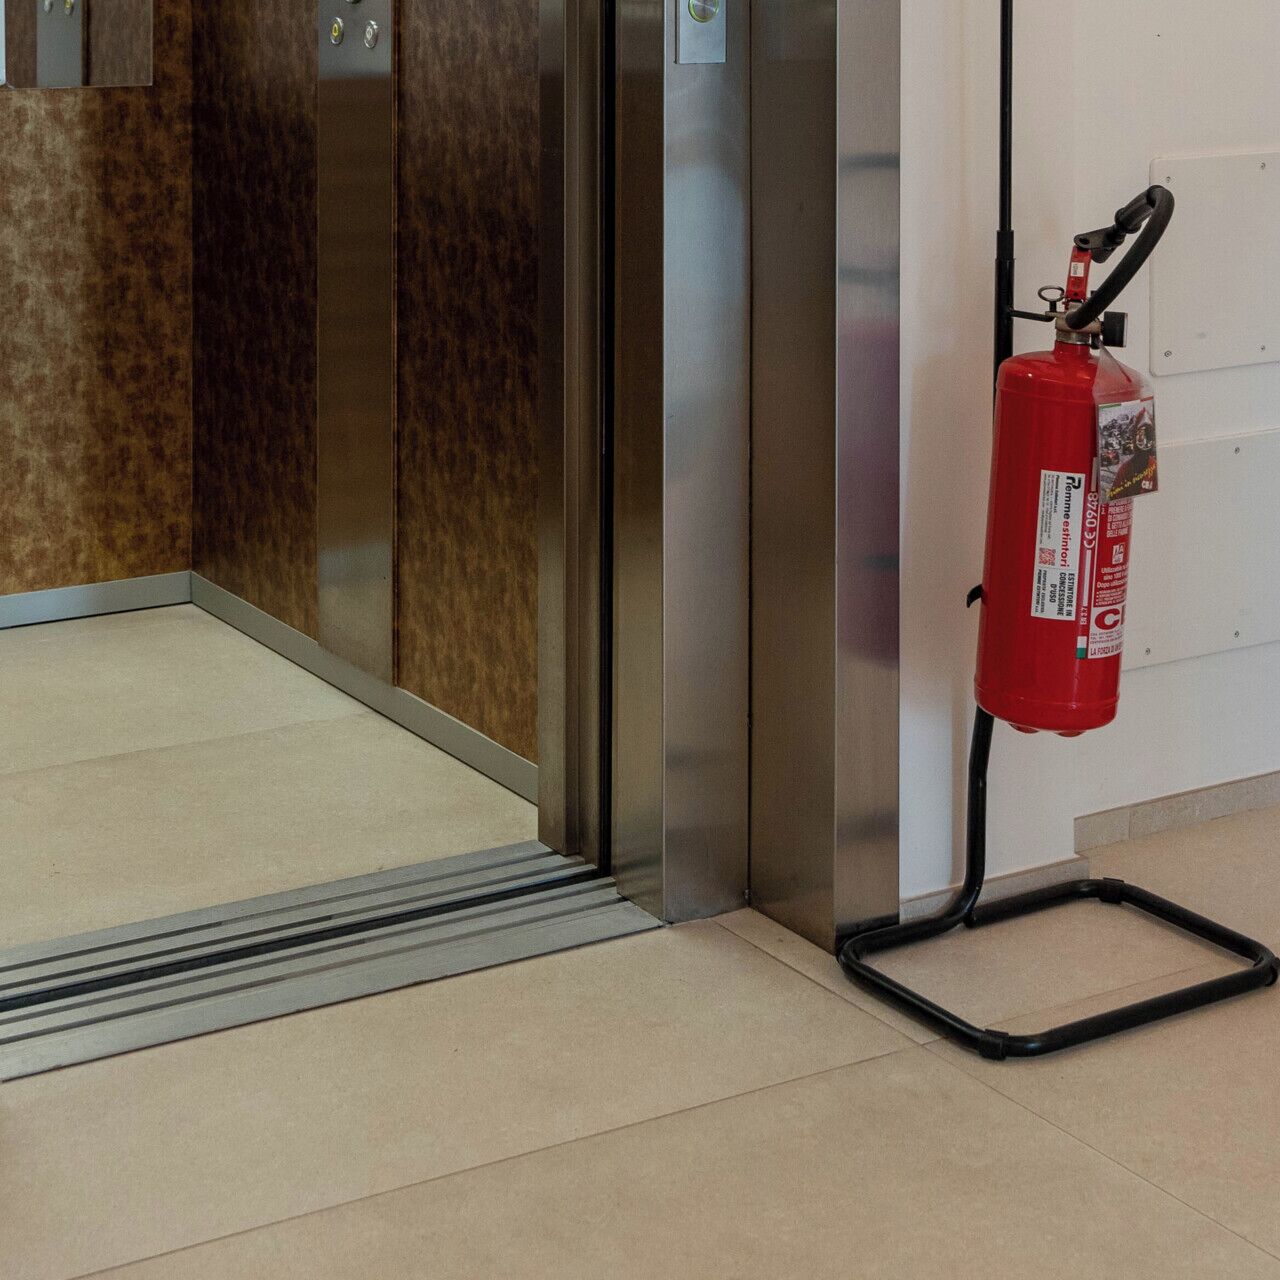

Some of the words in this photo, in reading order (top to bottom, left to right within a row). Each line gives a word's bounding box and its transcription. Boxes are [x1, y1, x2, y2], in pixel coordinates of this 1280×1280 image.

[1063, 476, 1082, 519] Piemme
[1085, 492, 1098, 528] 0948
[1060, 520, 1072, 567] estintori
[1049, 583, 1057, 603] D'USO
[1057, 572, 1066, 616] CONCESSIONE
[1066, 573, 1075, 608] ESTINTORE
[1065, 609, 1072, 617] IN
